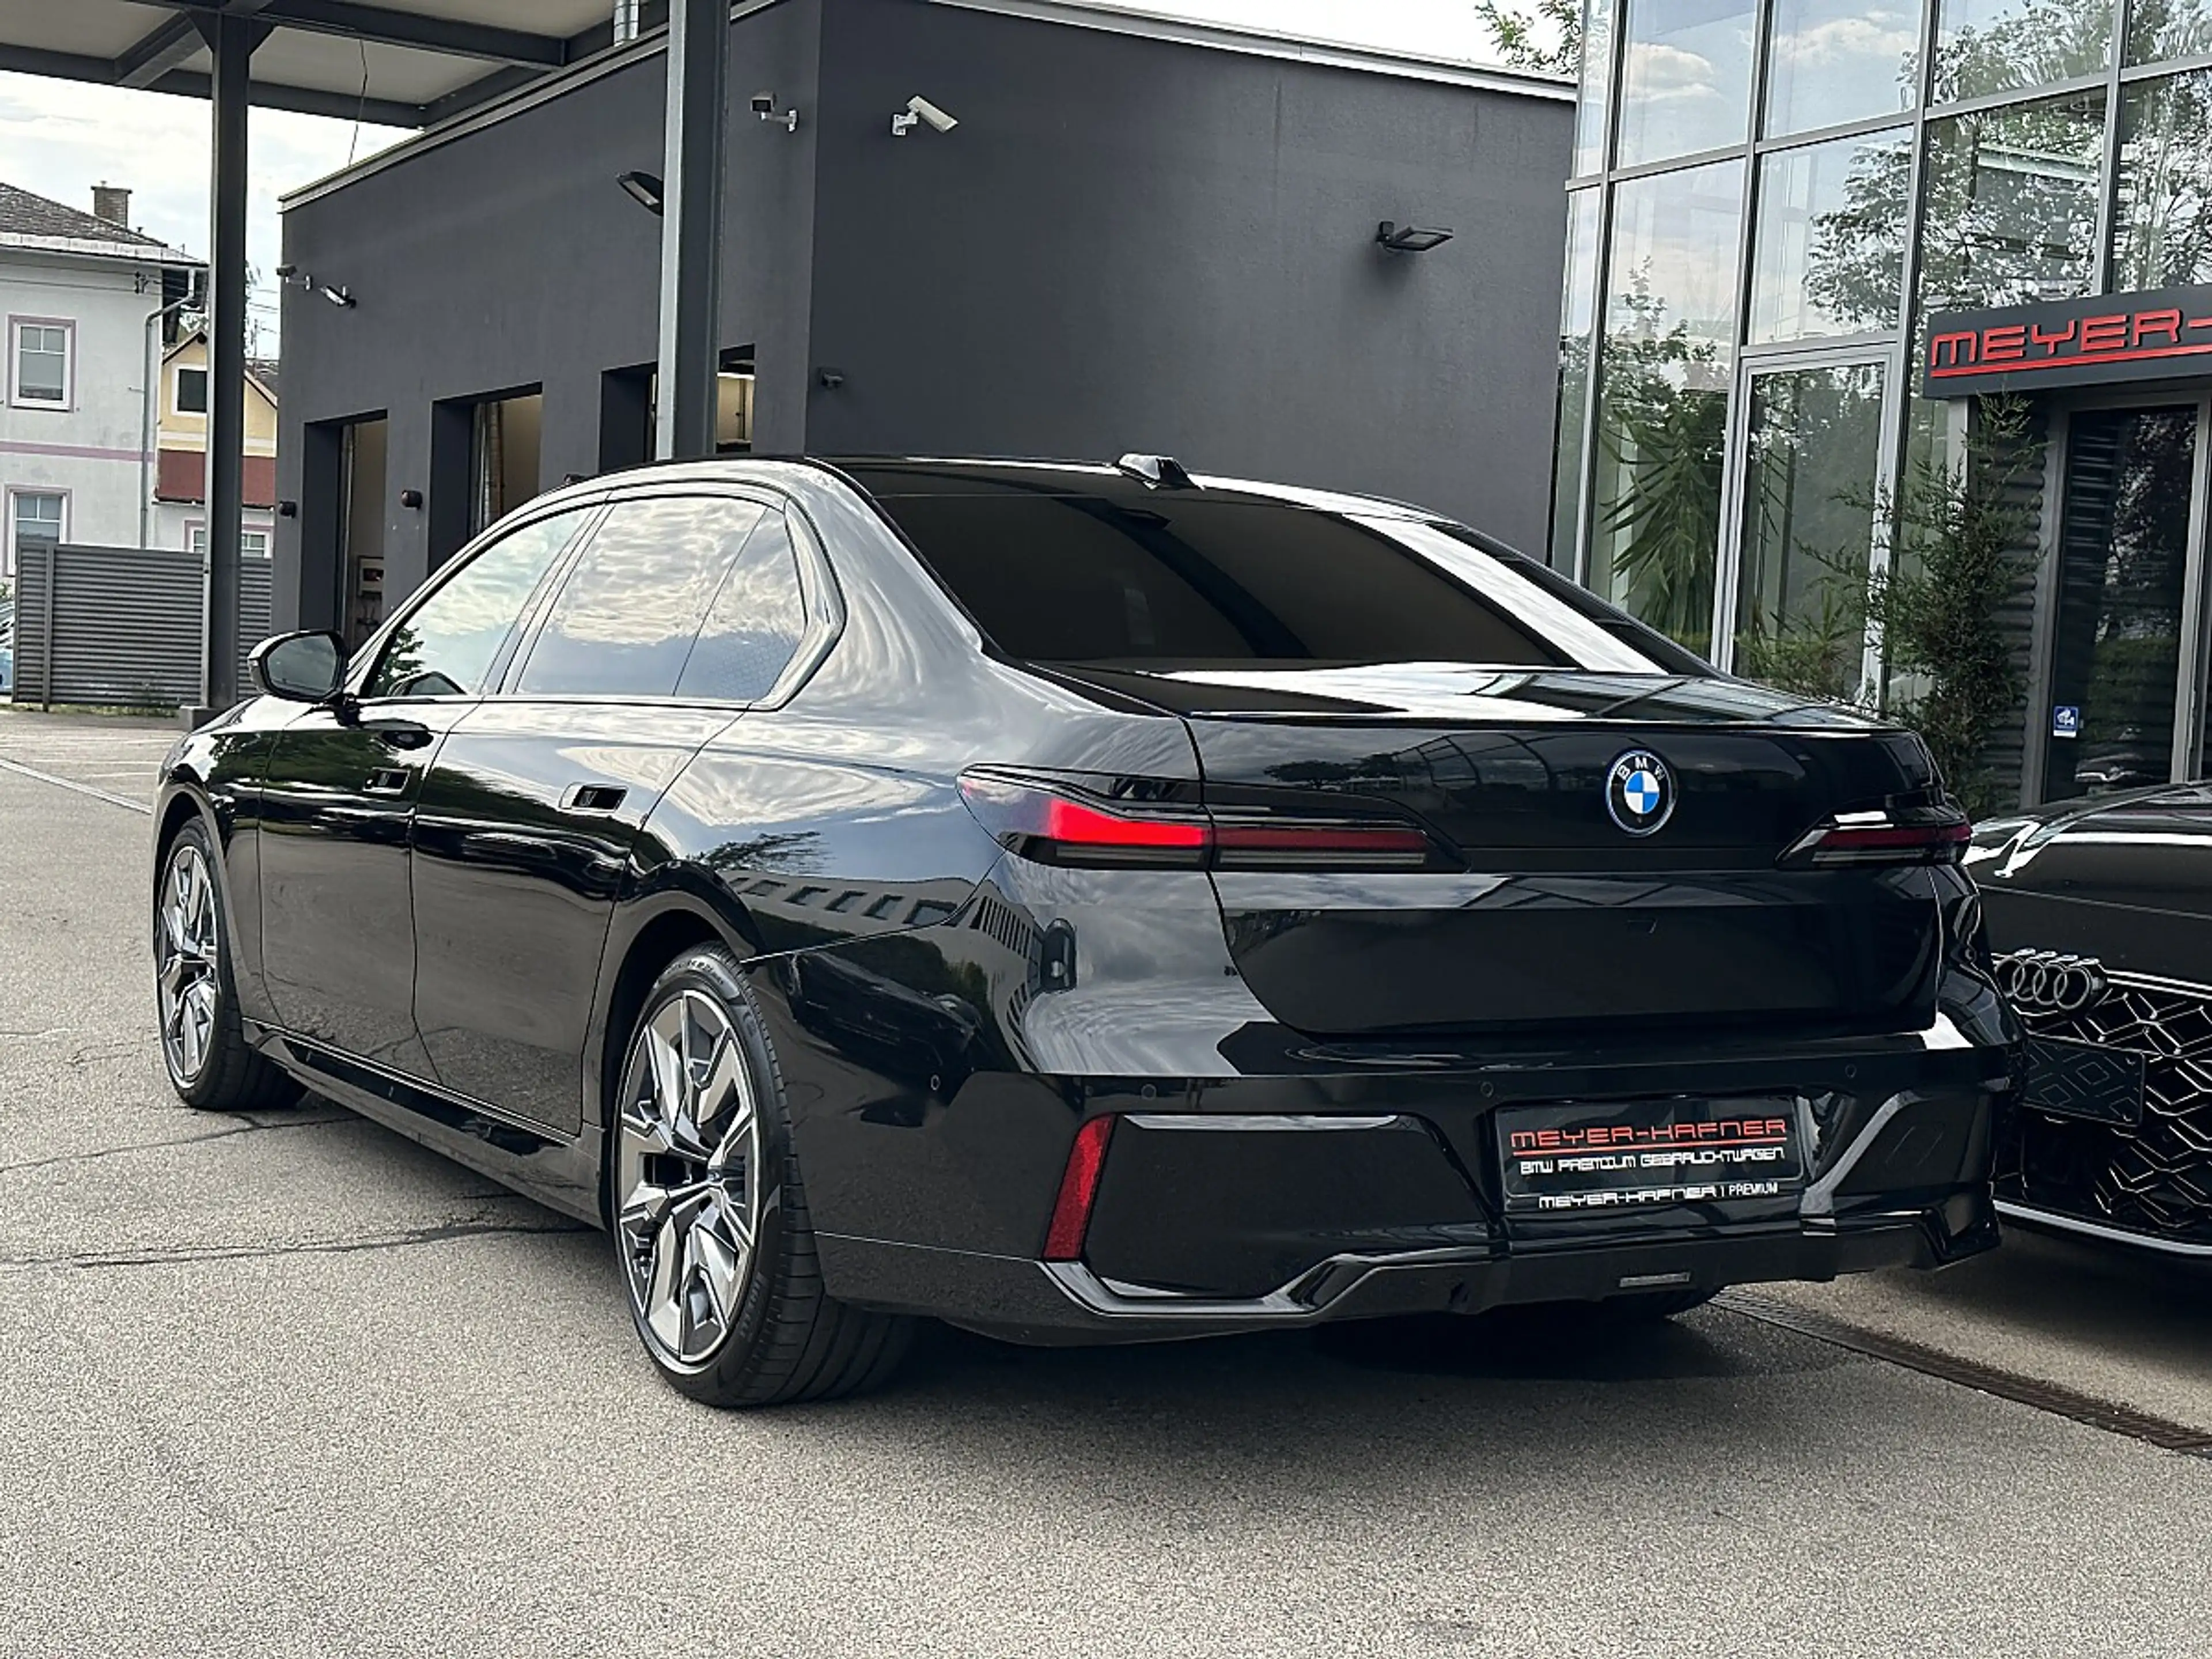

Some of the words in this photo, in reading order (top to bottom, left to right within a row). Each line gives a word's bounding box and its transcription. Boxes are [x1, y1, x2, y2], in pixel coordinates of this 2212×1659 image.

[1616, 756, 1665, 781] BMW
[1511, 1119, 1786, 1147] MEYER-HAFNER
[1520, 1159, 1553, 1175] BMW
[1558, 1155, 1636, 1172] PREMIUM
[1640, 1146, 1785, 1168] GEBRAUCHTWAGEN
[1539, 1185, 1717, 1209] MEYER-HAFNER
[1729, 1182, 1778, 1196] PREMIUM
